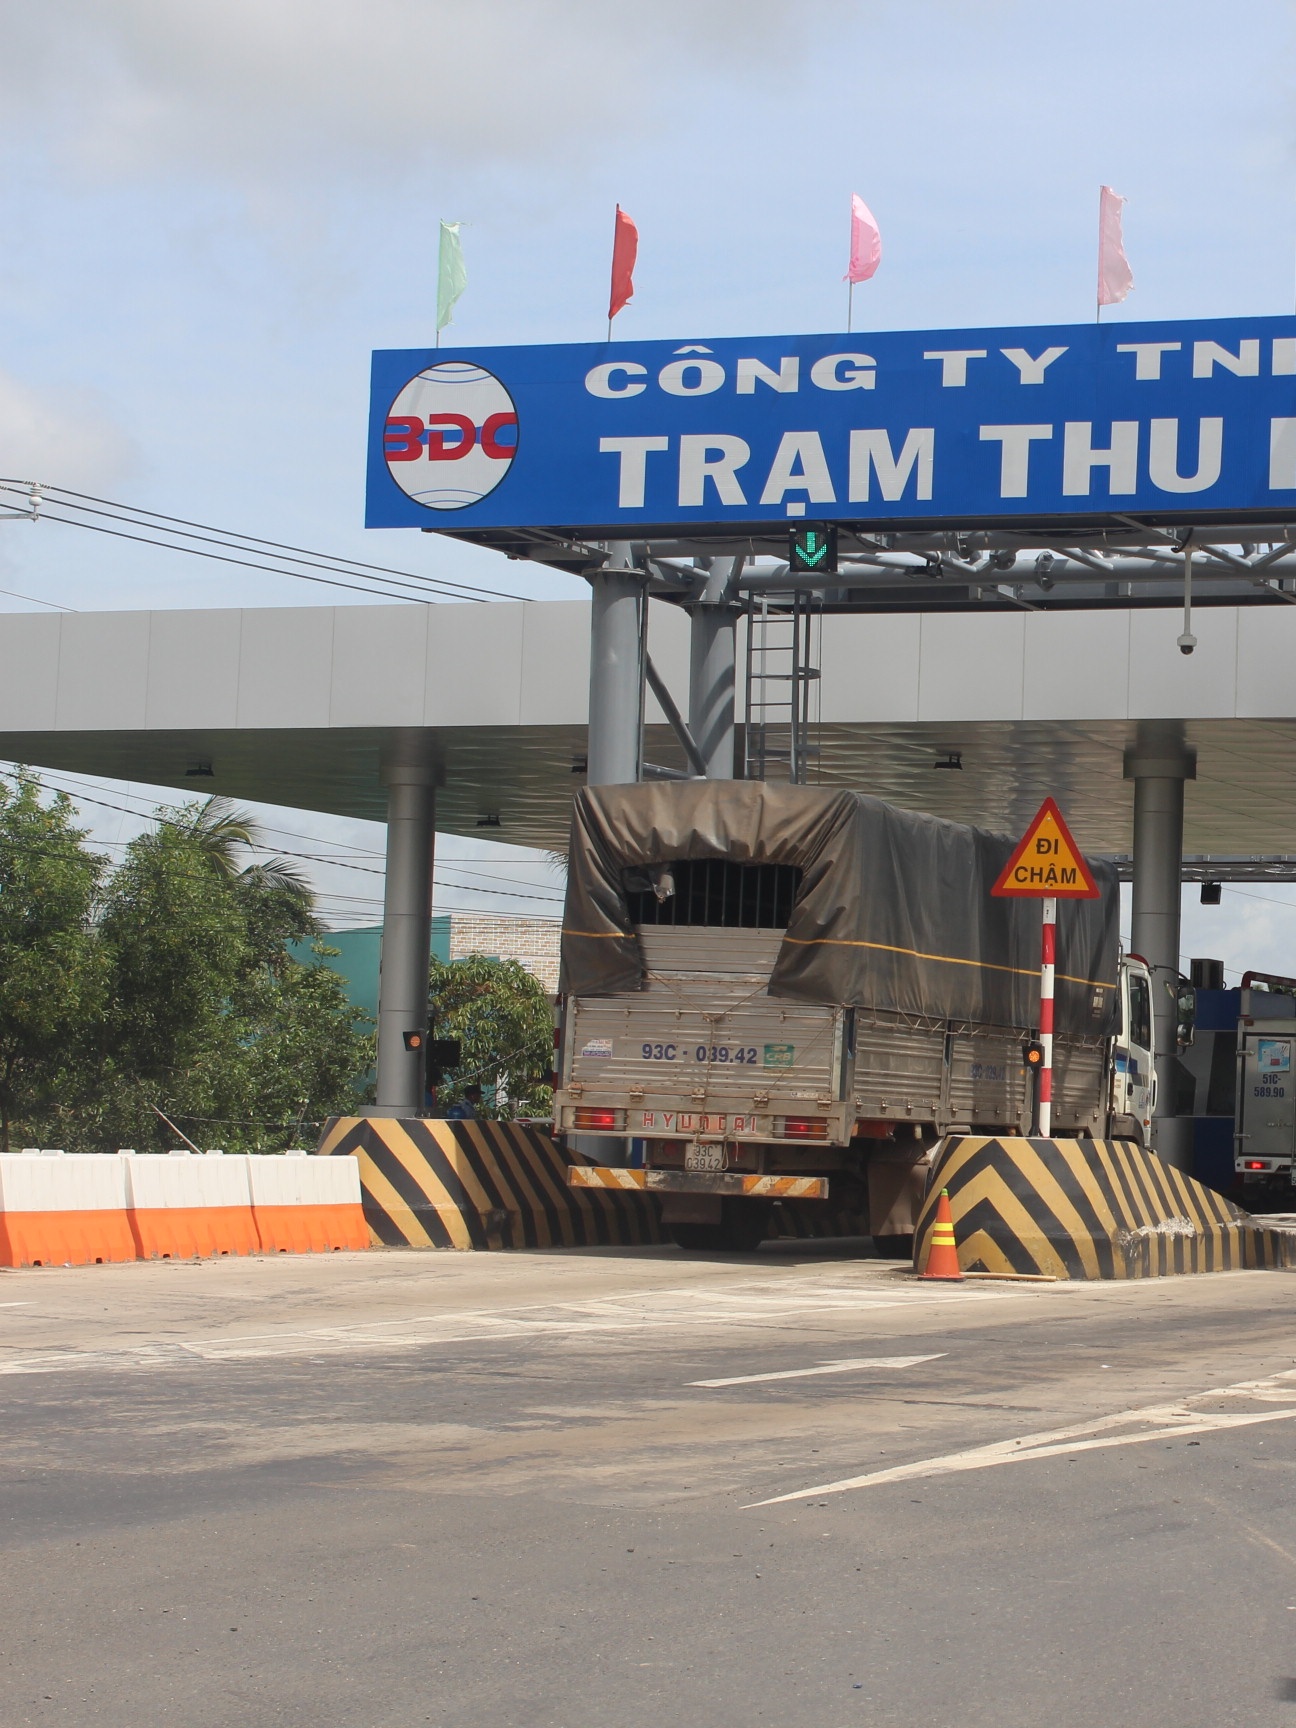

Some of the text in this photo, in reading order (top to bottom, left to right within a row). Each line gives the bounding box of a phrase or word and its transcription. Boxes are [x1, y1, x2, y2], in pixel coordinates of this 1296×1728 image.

[585, 345, 877, 399] CÔNG
[923, 346, 1070, 388] TY
[600, 427, 935, 517] TRẠM
[979, 416, 1224, 498] THU
[1036, 838, 1059, 855] ĐI
[1014, 863, 1077, 886] CHẬM
[642, 1043, 677, 1060] 93C
[695, 1045, 758, 1064] 039.42
[1254, 1087, 1285, 1098] 589.90
[642, 1112, 757, 1132] HYUNDAI
[687, 1157, 721, 1170] 039.42
